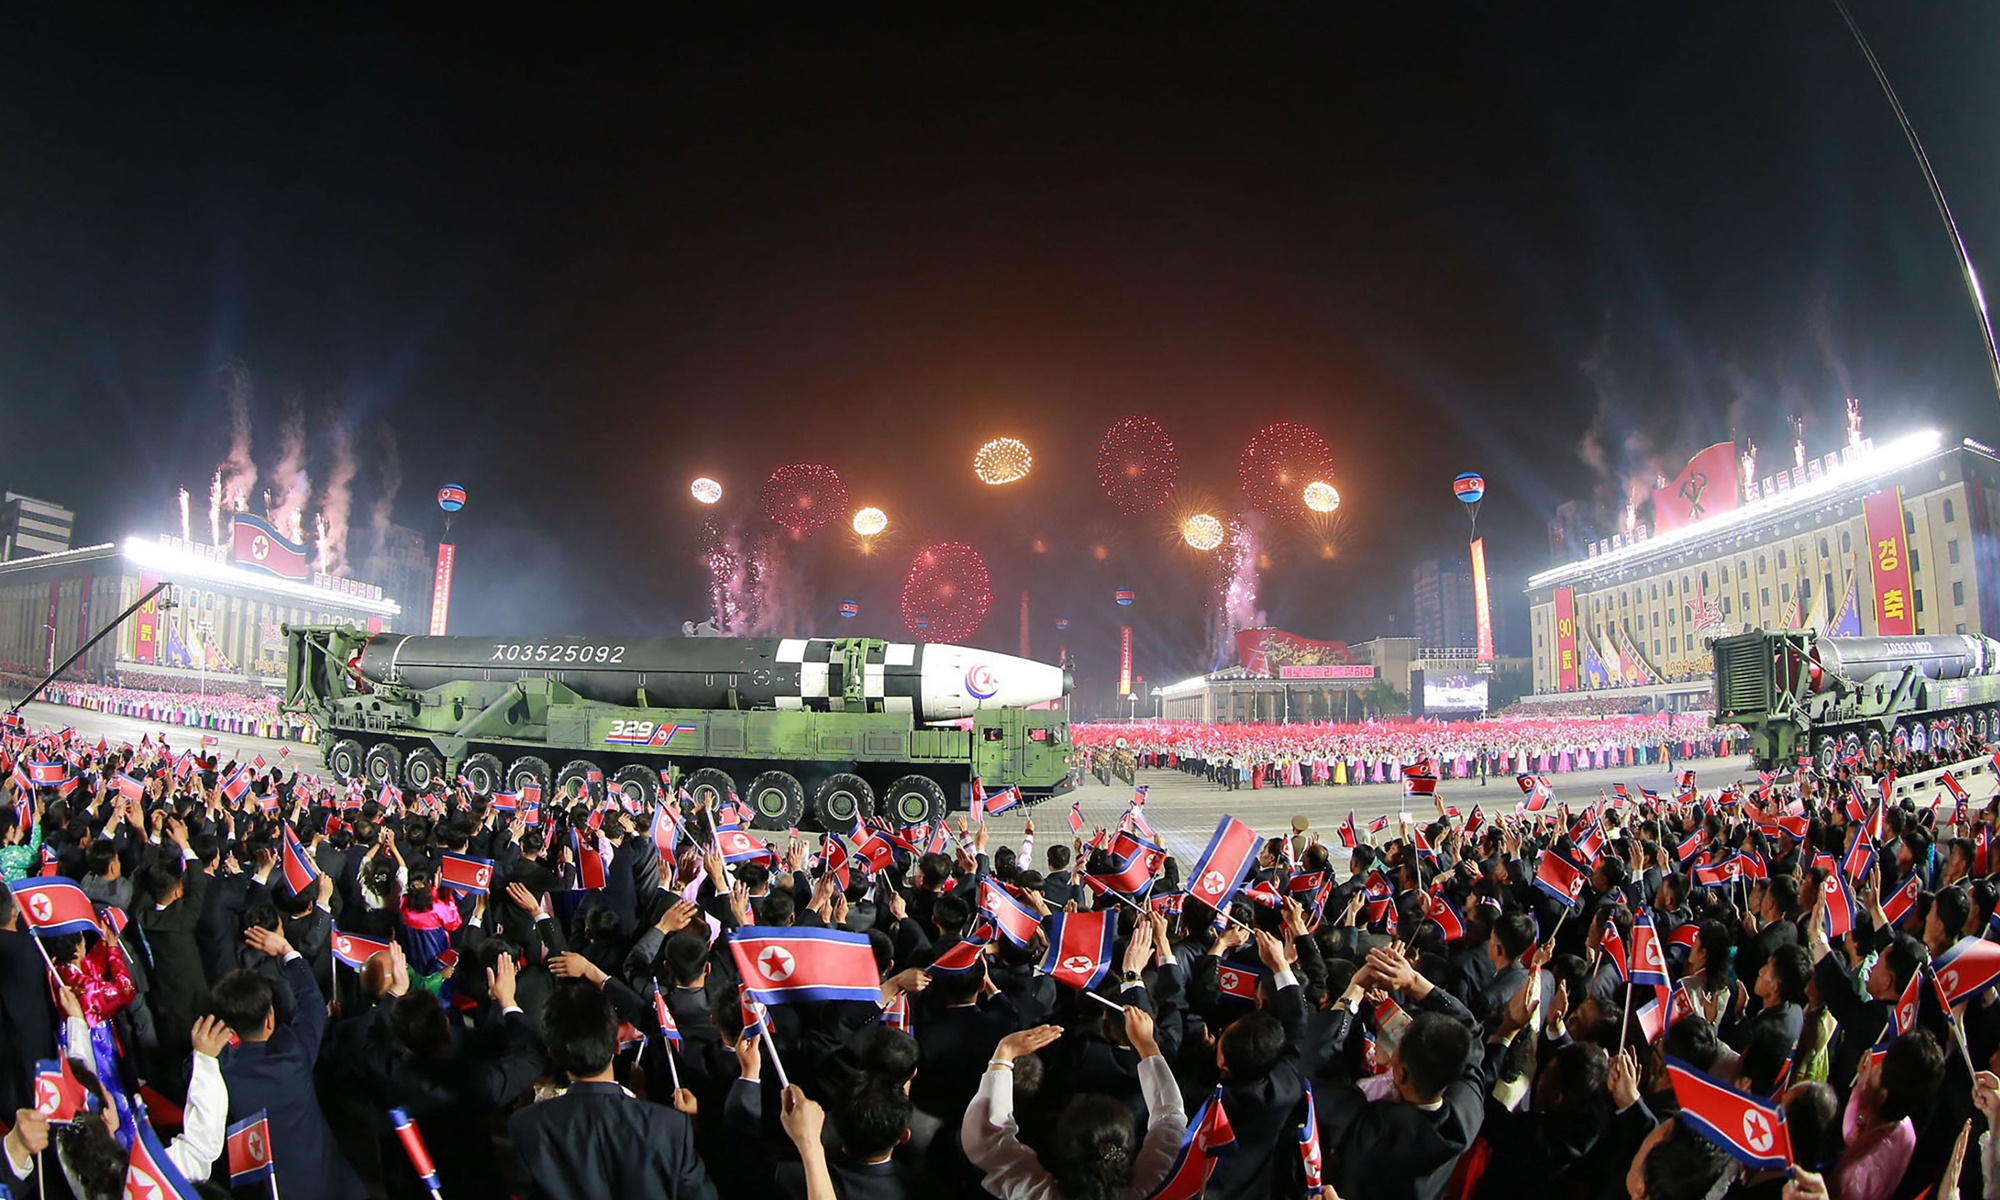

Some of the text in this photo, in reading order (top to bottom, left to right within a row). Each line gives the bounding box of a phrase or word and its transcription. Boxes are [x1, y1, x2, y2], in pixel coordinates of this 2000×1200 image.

[1878, 537, 1904, 620] 경축
[1559, 617, 1572, 638] 90
[608, 720, 655, 737] 329
